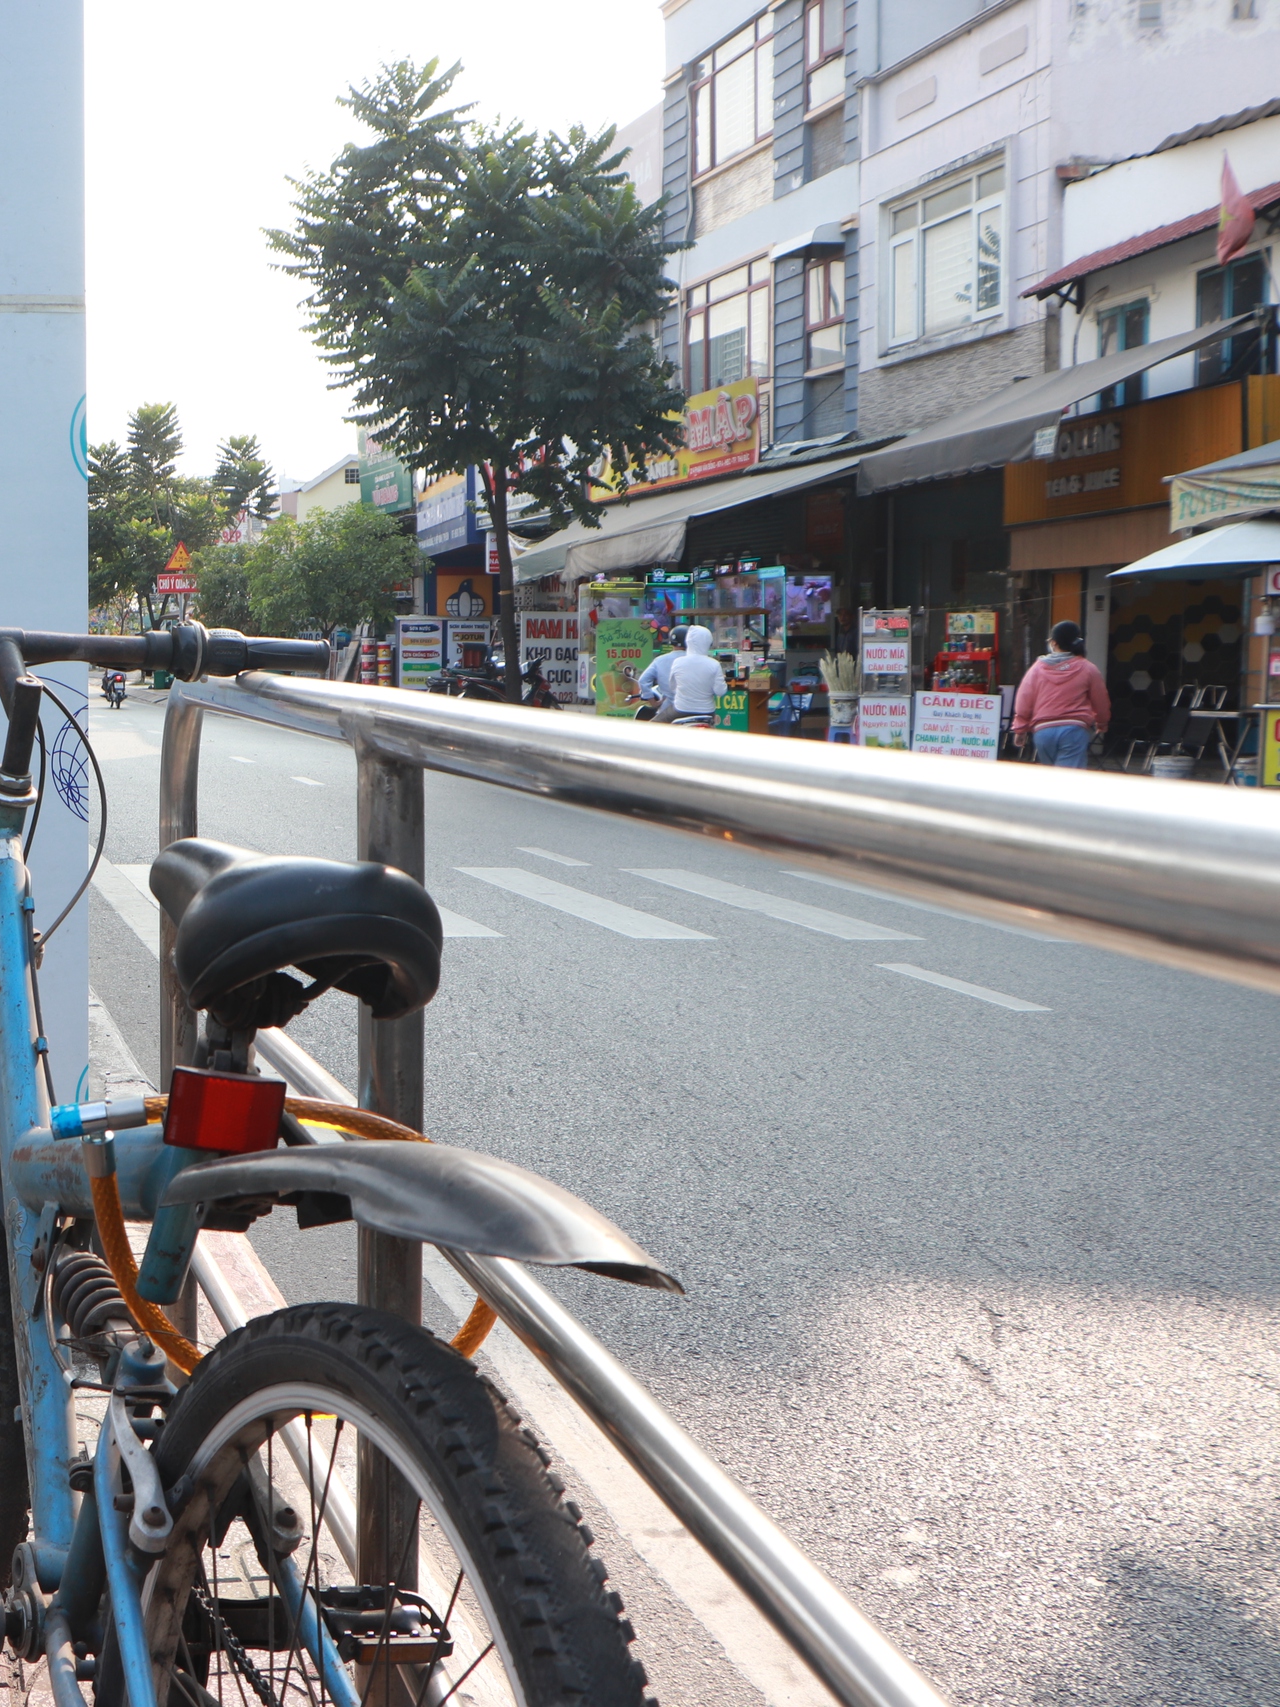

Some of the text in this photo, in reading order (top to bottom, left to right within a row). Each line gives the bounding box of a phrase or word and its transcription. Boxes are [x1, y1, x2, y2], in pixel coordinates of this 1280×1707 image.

[1058, 421, 1121, 460] OLLAR
[159, 576, 170, 590] CHÚ
[170, 576, 175, 590] Ý
[526, 618, 563, 639] NAM
[525, 646, 552, 661] KHO
[606, 648, 642, 659] 15.000
[866, 647, 905, 659] NƯỚC MÍA
[547, 669, 572, 687] CỰC
[724, 691, 746, 710] CÂY
[959, 697, 995, 710] ĐIẾC
[862, 703, 907, 716] NƯỚC MÍA
[923, 722, 939, 731] CAM
[915, 733, 996, 747] CHANH DÂY NƯỚC MÍA
